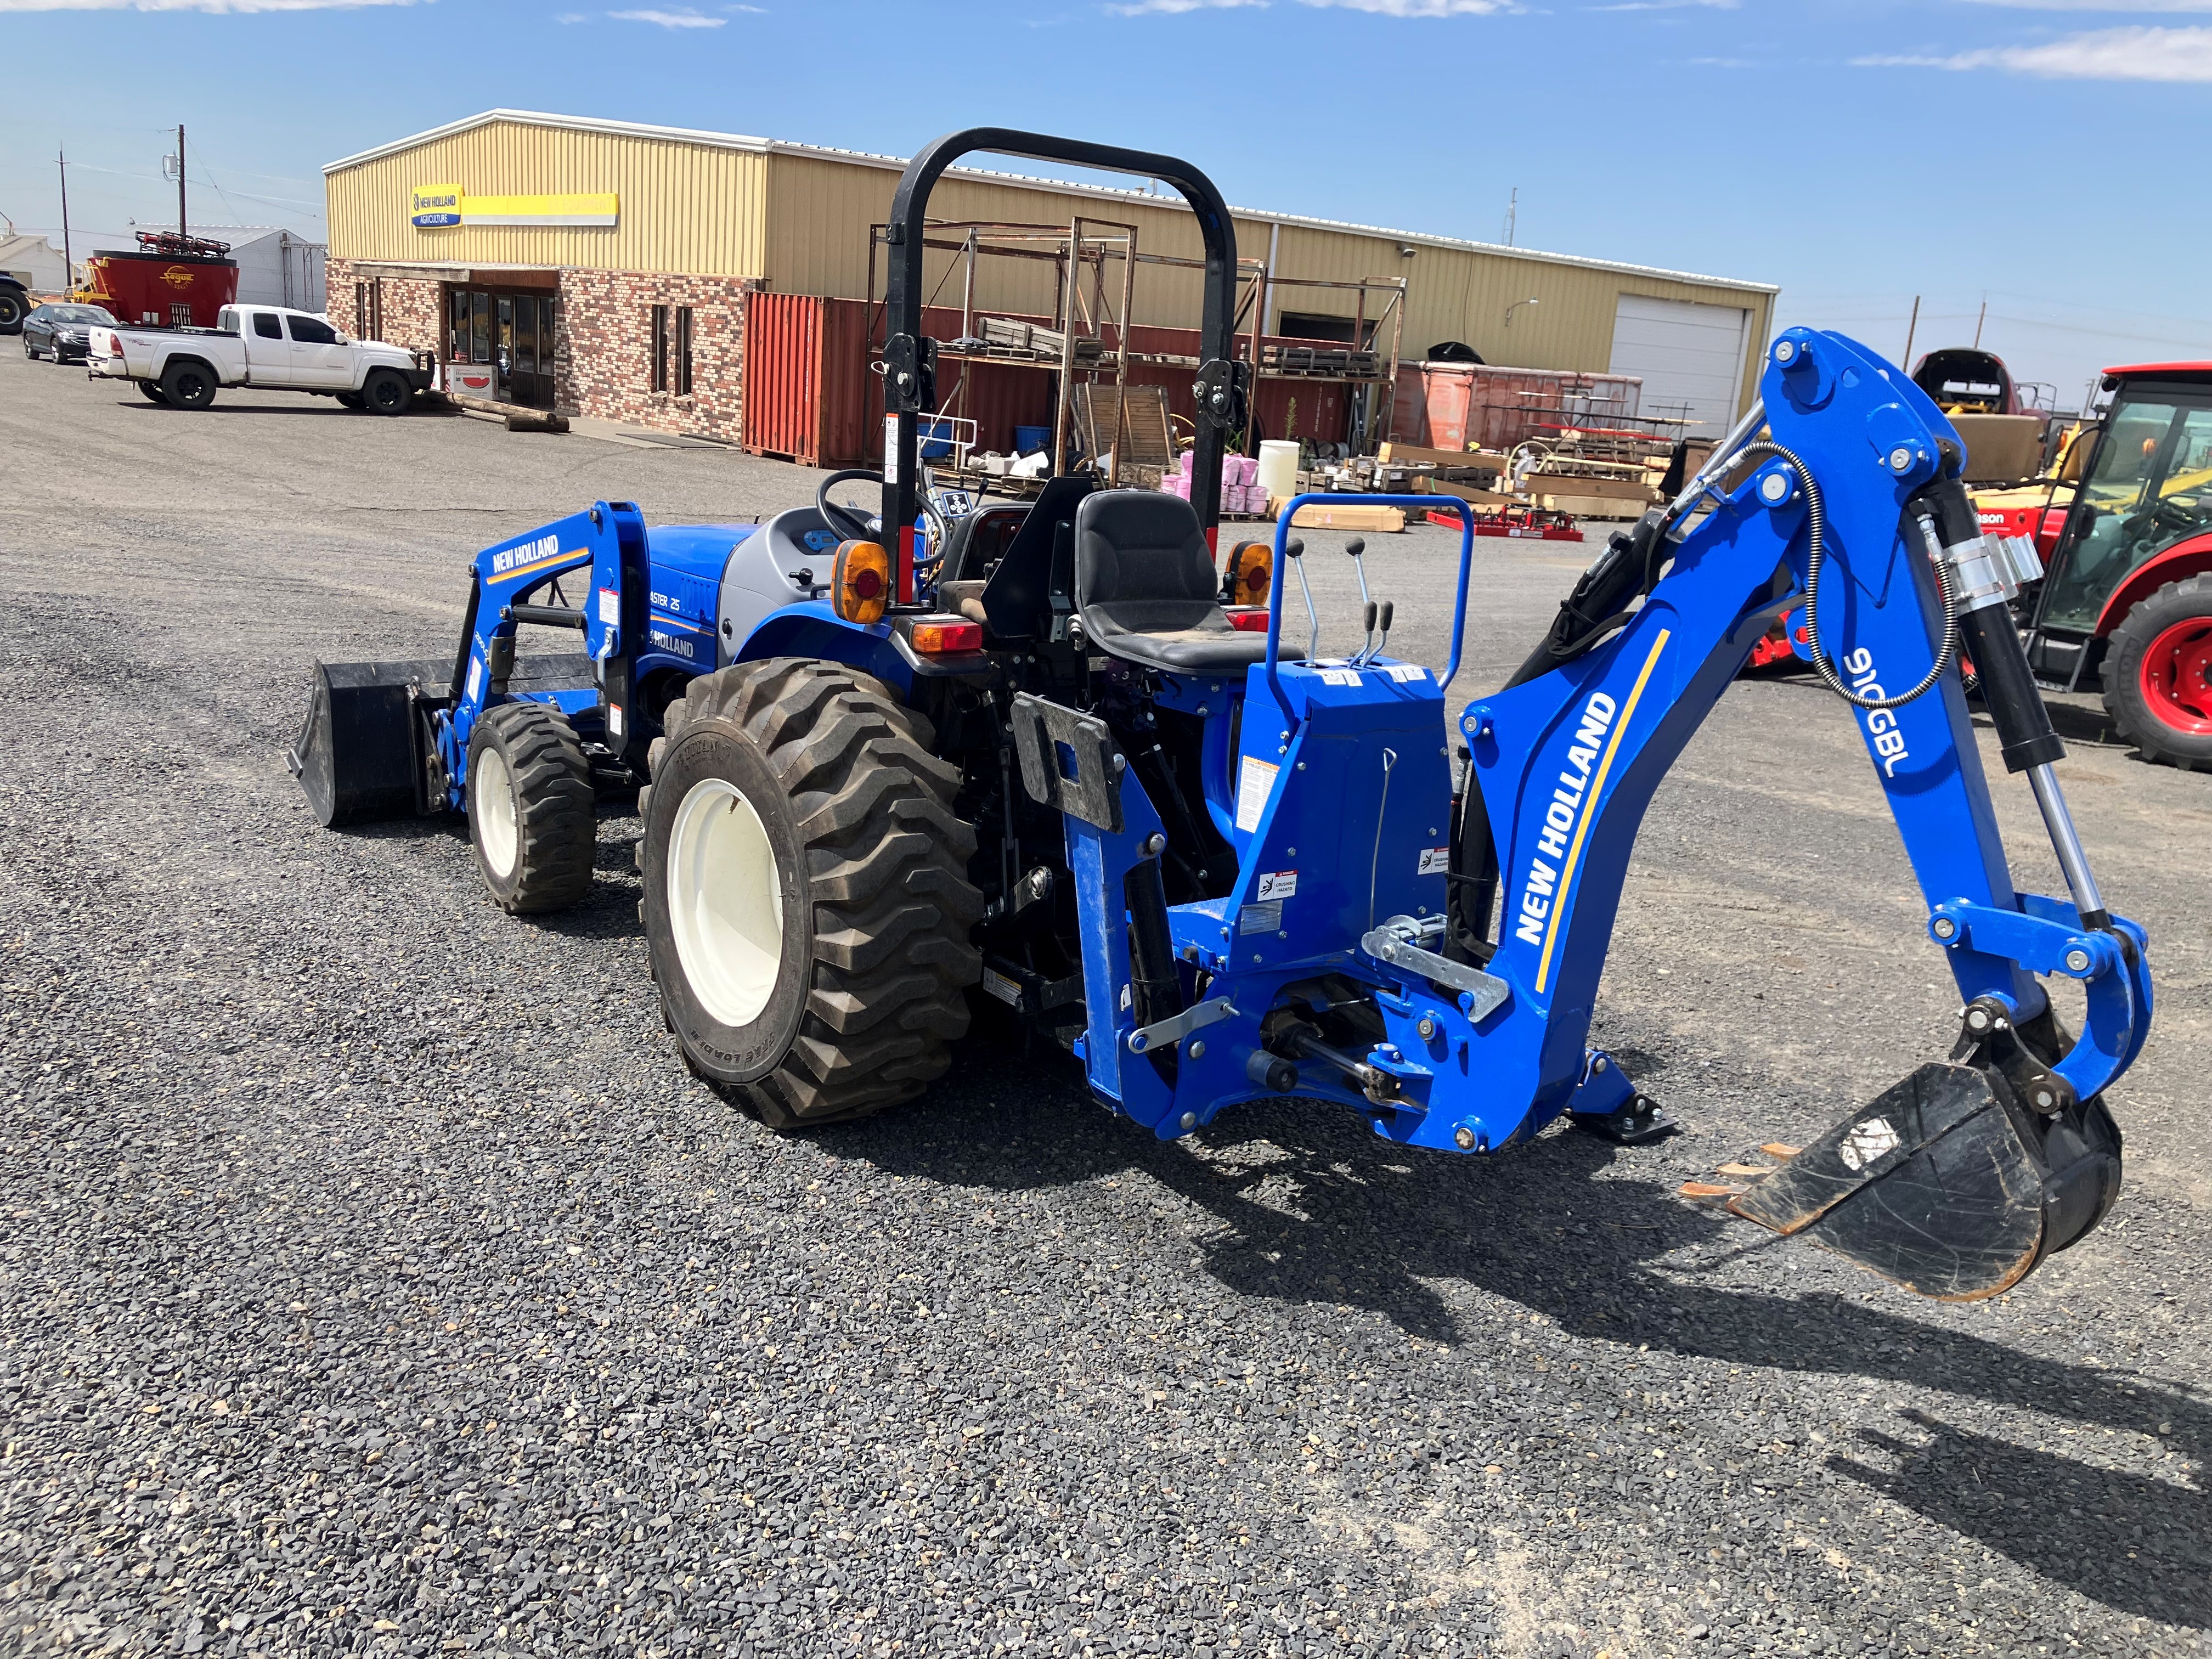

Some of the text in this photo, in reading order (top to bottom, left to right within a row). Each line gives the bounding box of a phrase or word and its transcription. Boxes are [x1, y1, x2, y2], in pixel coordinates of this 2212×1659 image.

[420, 195, 455, 208] NEW HOLLAND
[420, 214, 448, 224] AGRICULTURE
[493, 534, 558, 573] NEW HOLLAND
[650, 591, 680, 611] ASTER 25
[653, 630, 693, 658] HOLLAND
[1843, 647, 1909, 778] 910GBL
[684, 739, 719, 760] TITAN
[1516, 691, 1616, 946] NEW HOLLAND
[690, 1029, 775, 1064] TRAC LOADER
